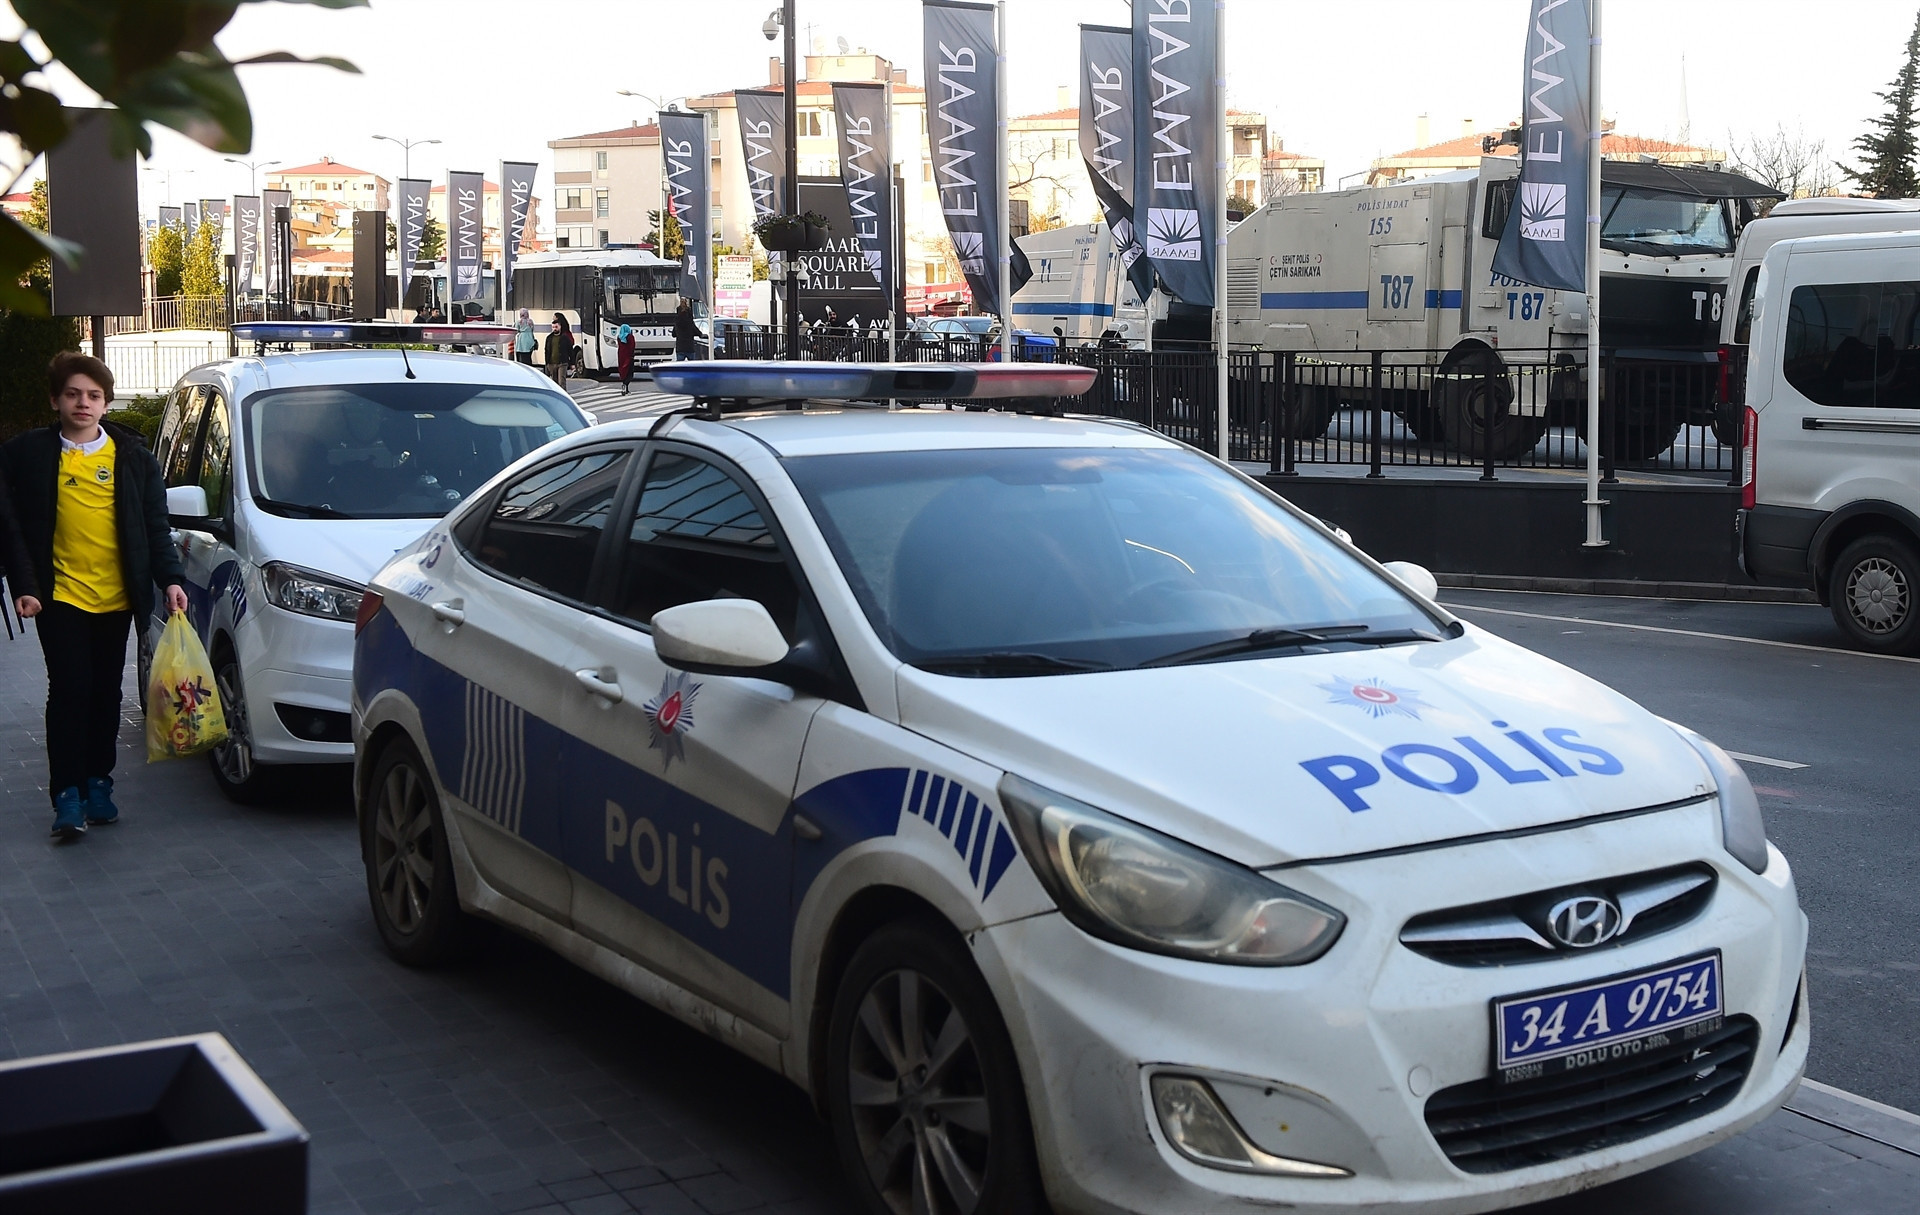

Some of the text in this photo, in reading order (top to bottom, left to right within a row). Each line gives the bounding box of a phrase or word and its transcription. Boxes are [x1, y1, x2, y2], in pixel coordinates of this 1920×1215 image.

[1368, 216, 1392, 236] 155
[798, 237, 864, 253] AAR
[1380, 275, 1414, 309] T87
[1691, 291, 1723, 322] T 8
[1298, 720, 1625, 813] POLİS
[605, 799, 729, 929] POLİS
[1511, 1000, 1568, 1053] 34
[1573, 993, 1611, 1040] A
[1624, 966, 1711, 1029] 9754
[1565, 1048, 1608, 1069] DOLU
[1612, 1041, 1642, 1060] OTO
